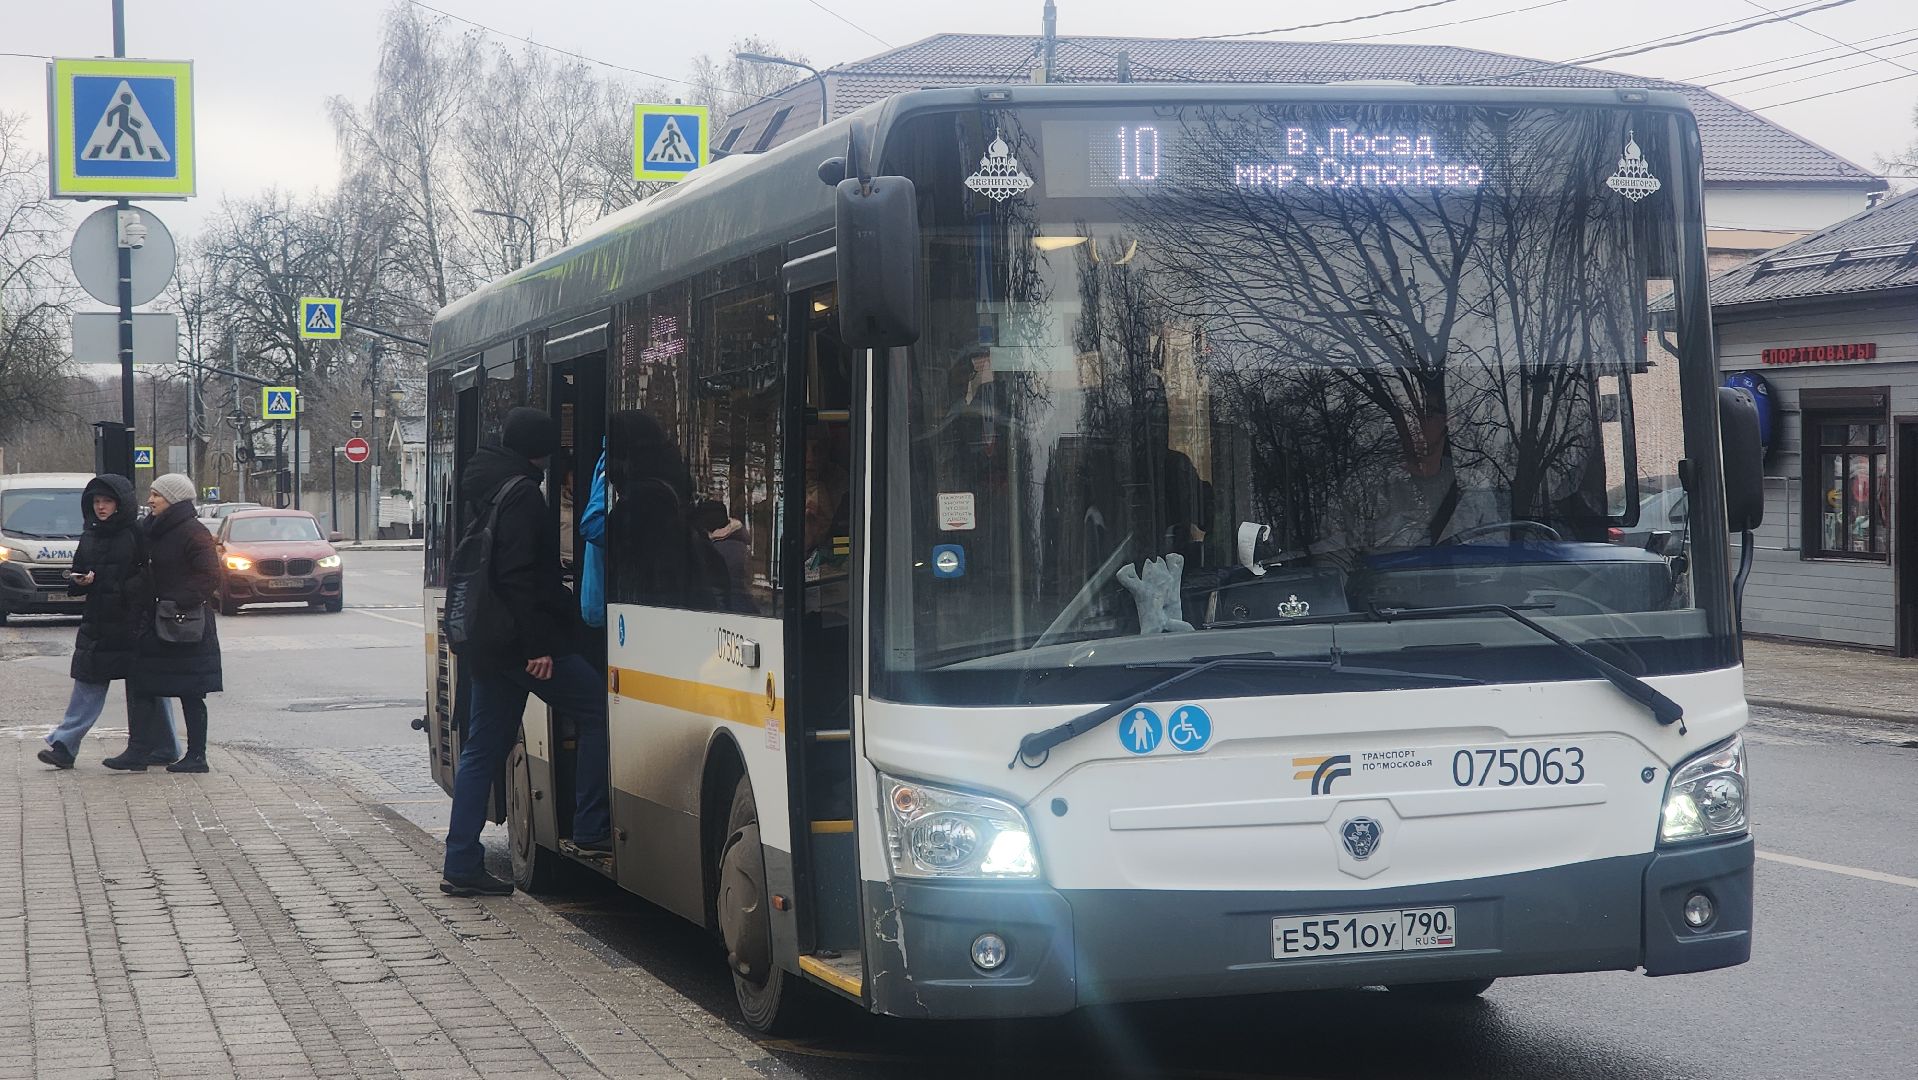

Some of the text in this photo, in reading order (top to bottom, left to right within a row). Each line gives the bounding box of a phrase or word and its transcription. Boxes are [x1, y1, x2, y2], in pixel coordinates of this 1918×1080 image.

[1117, 125, 1159, 181] 10
[1286, 127, 1436, 159] В.Посад
[969, 178, 1030, 188] ЗВЕНИГОРОД
[1234, 158, 1484, 189] мкр.Супонево
[1610, 178, 1658, 188] ЗВЕНИГОРОД
[1761, 342, 1876, 365] СПОРТТОВАРЫ
[450, 580, 469, 620] PUMA
[1362, 750, 1416, 761] ТРАНСПОРТ
[1452, 747, 1585, 787] 075063
[1403, 911, 1448, 937] 790
[1415, 936, 1438, 946] RUS
